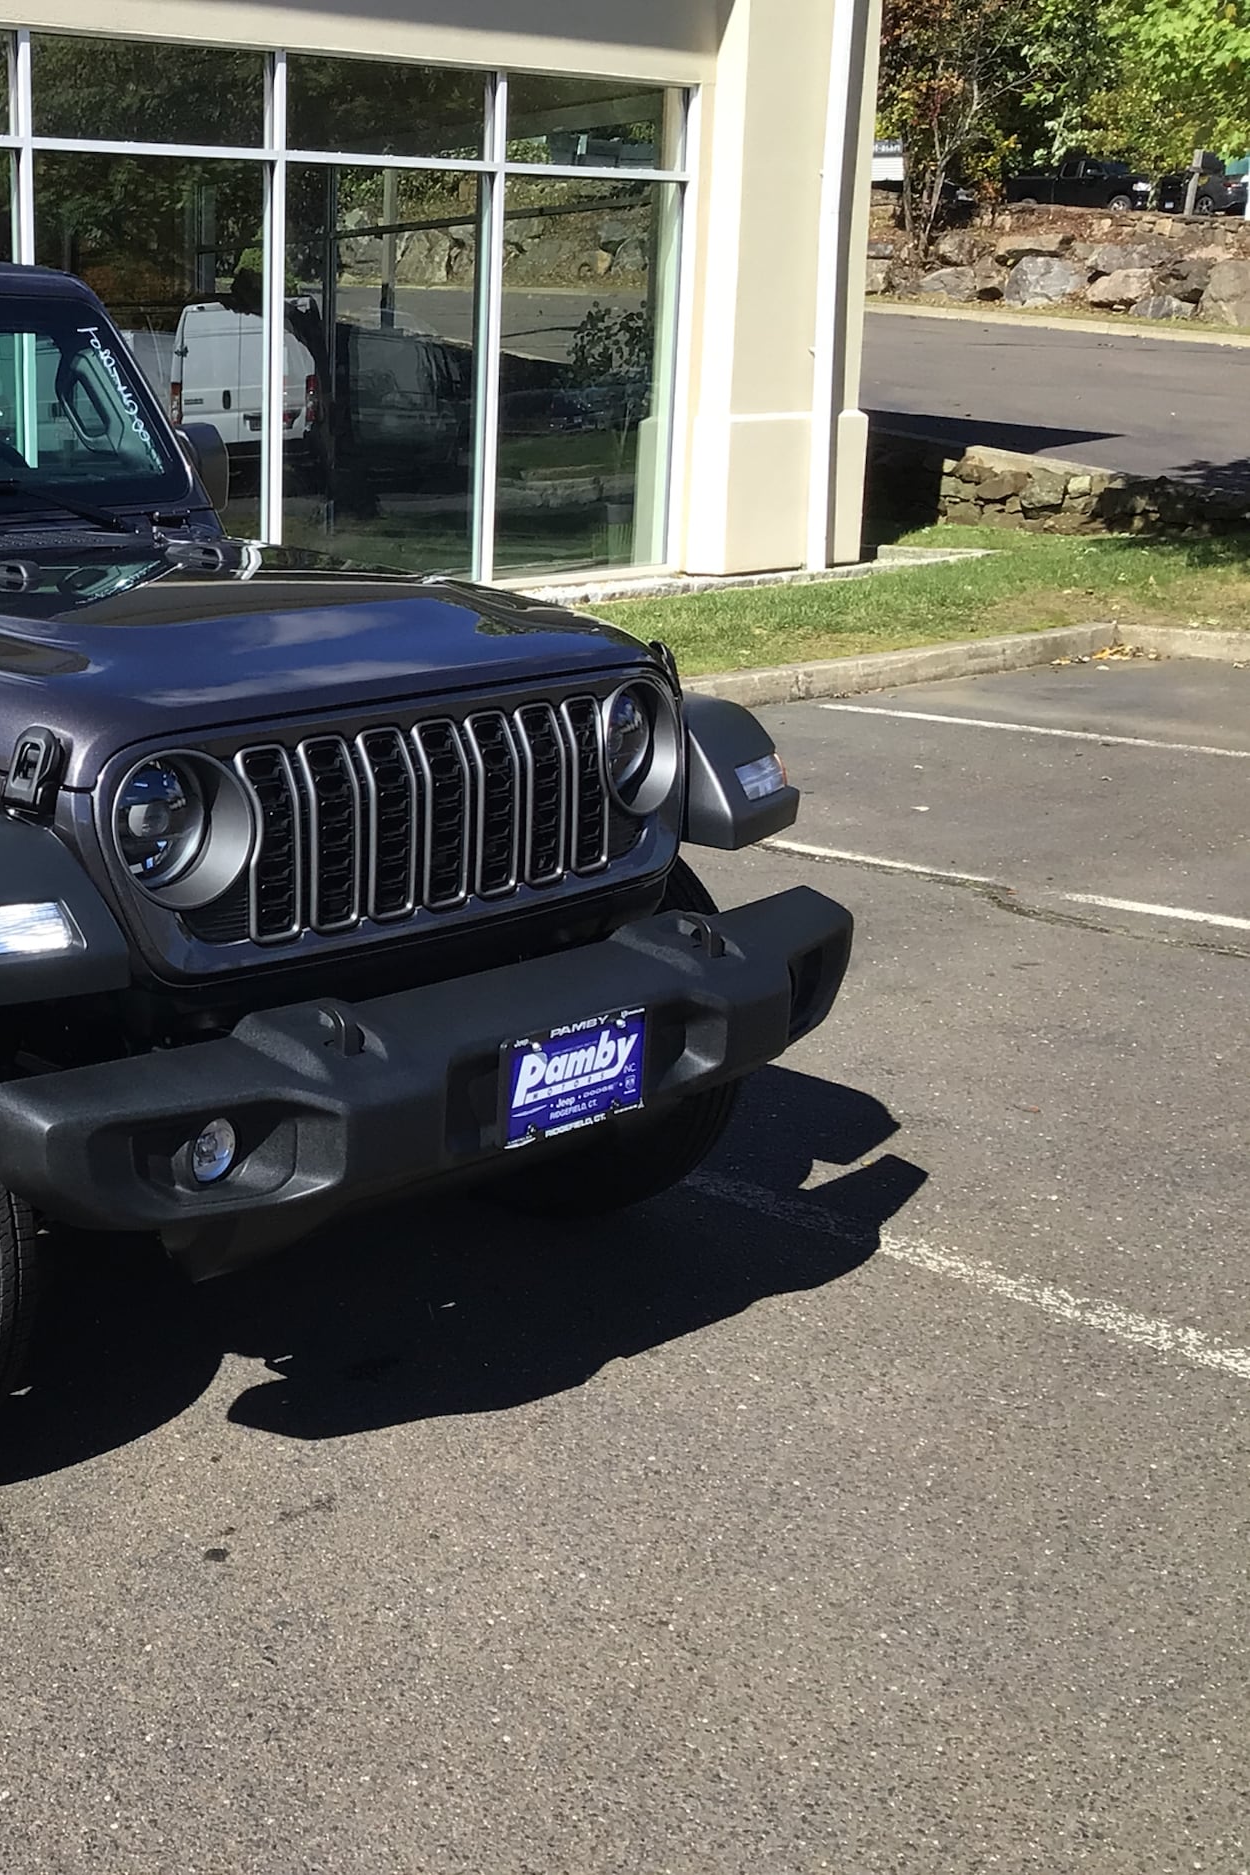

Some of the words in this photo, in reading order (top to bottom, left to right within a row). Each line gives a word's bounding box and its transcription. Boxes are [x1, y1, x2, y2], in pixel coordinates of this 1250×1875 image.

[550, 1014, 609, 1039] PAMBY
[511, 1030, 639, 1109] Pamby
[532, 1073, 606, 1101] MOTORS
[555, 1096, 576, 1109] Jeep
